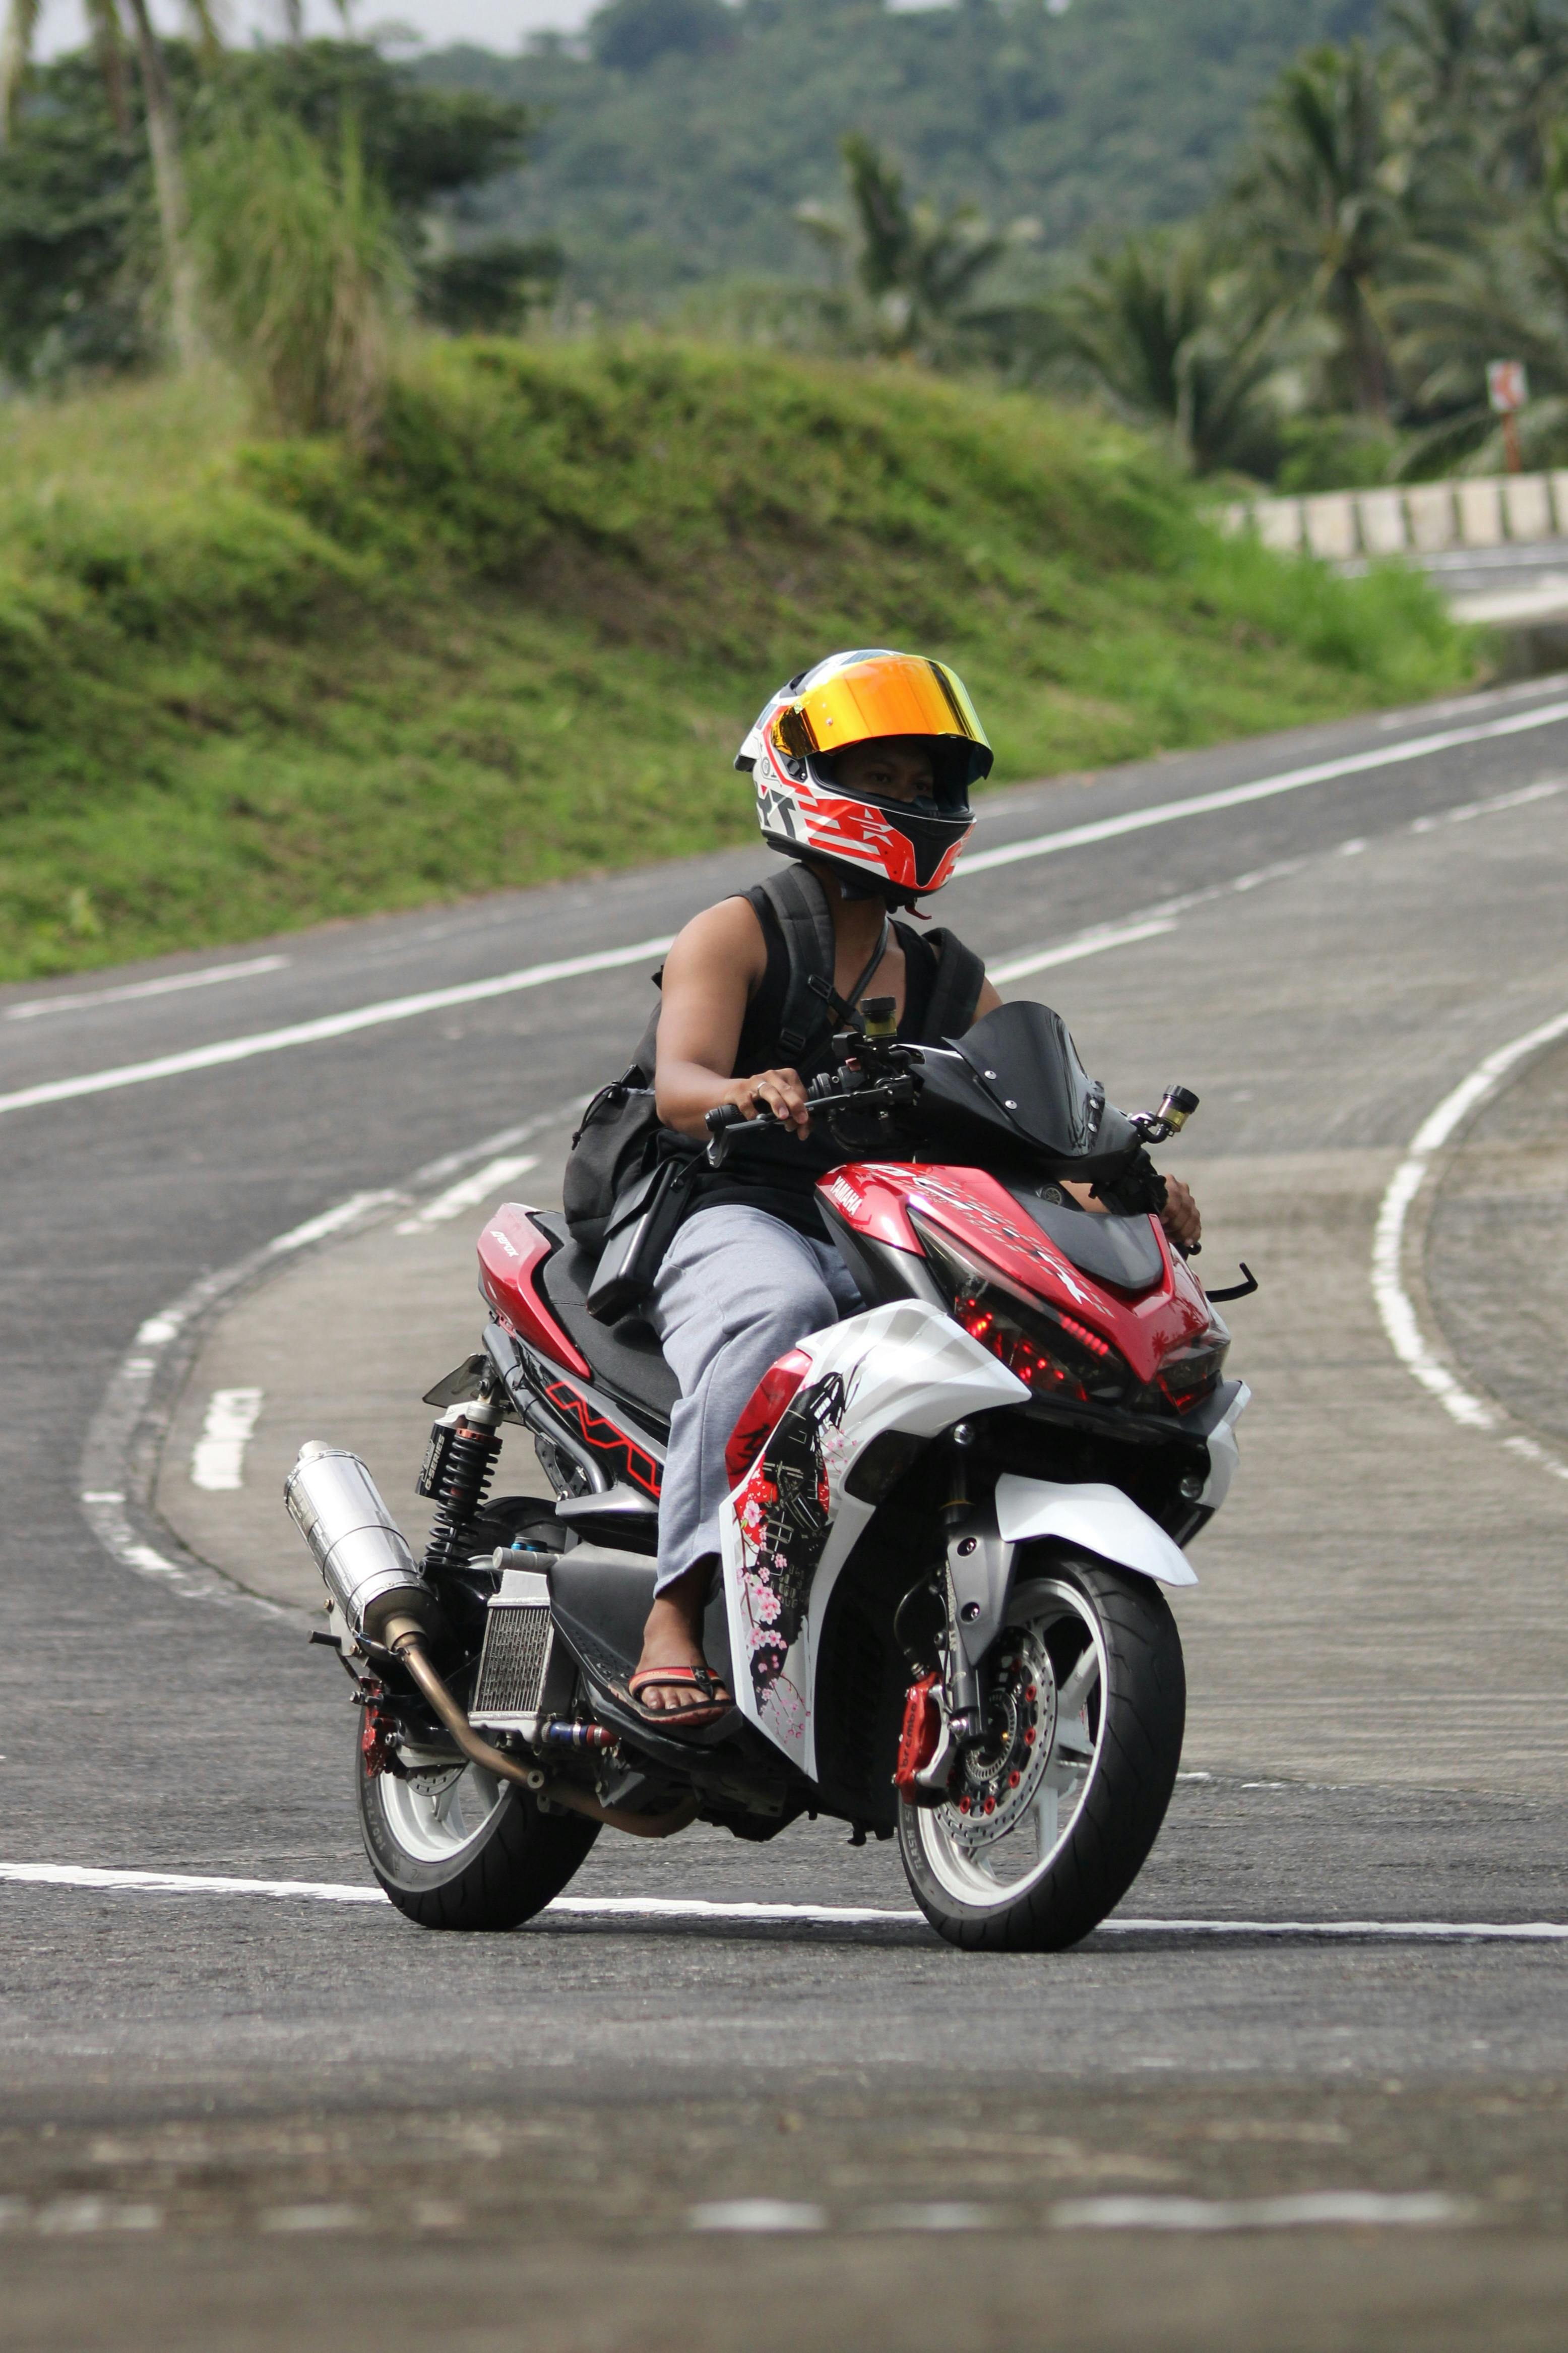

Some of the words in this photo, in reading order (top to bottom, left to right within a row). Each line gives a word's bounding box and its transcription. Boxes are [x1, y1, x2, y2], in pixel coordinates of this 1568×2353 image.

[830, 1175, 862, 1216] YAMAHA
[489, 1231, 519, 1257] AEROX
[425, 1433, 445, 1490] G-SERIES
[900, 1703, 916, 1767] brembo
